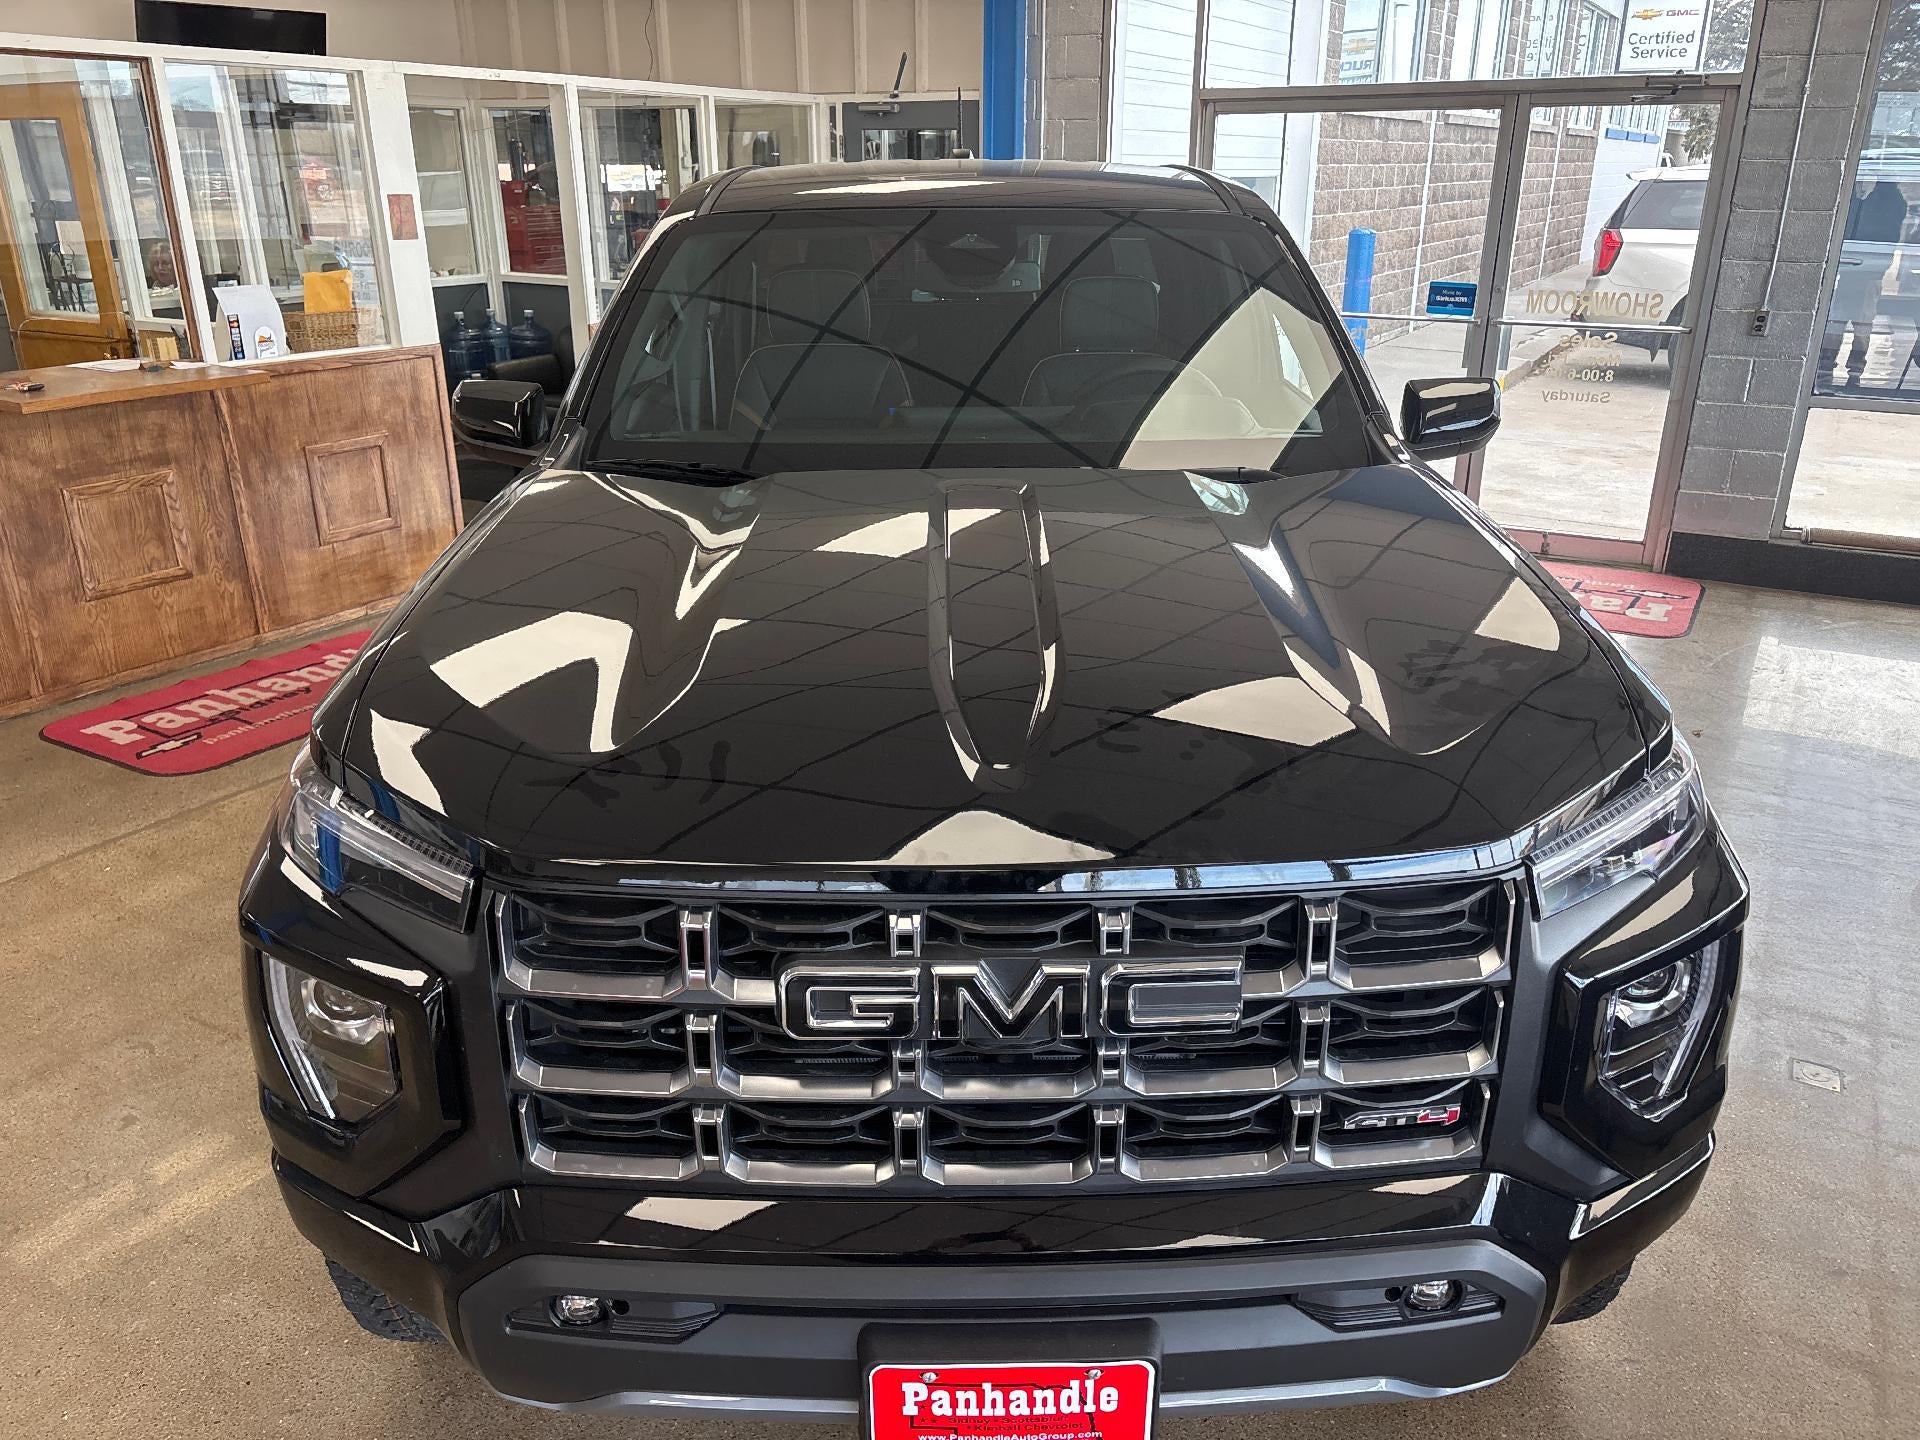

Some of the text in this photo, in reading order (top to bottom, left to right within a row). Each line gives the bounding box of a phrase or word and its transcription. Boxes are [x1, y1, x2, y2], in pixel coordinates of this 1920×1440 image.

[1666, 9, 1700, 17] GMC
[1628, 30, 1696, 45] Certified
[1630, 46, 1688, 59] Service
[776, 956, 1243, 1041] GMC
[1343, 1105, 1461, 1130] AT4
[902, 1379, 1119, 1416] Panhandle
[1024, 1422, 1083, 1431] Chevrolet
